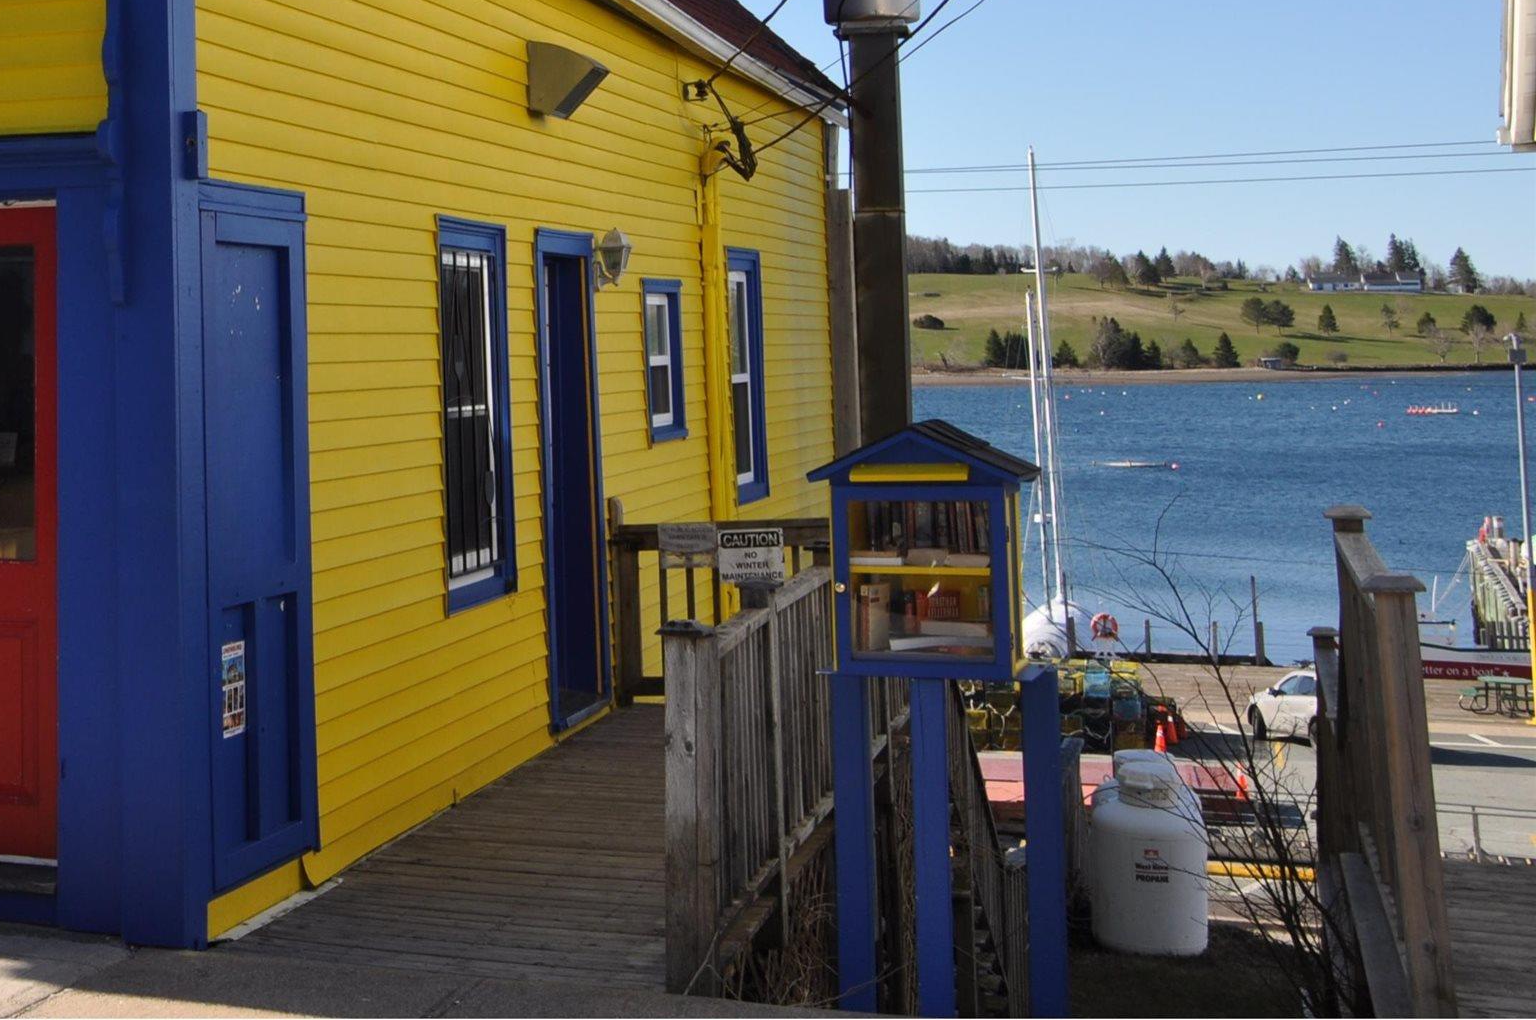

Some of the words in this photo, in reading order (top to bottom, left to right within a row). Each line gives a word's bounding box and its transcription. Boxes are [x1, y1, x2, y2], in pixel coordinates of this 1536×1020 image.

[723, 533, 778, 546] CAUTION
[745, 551, 757, 559] NO
[1446, 666, 1459, 676] on
[1462, 667, 1469, 677] a
